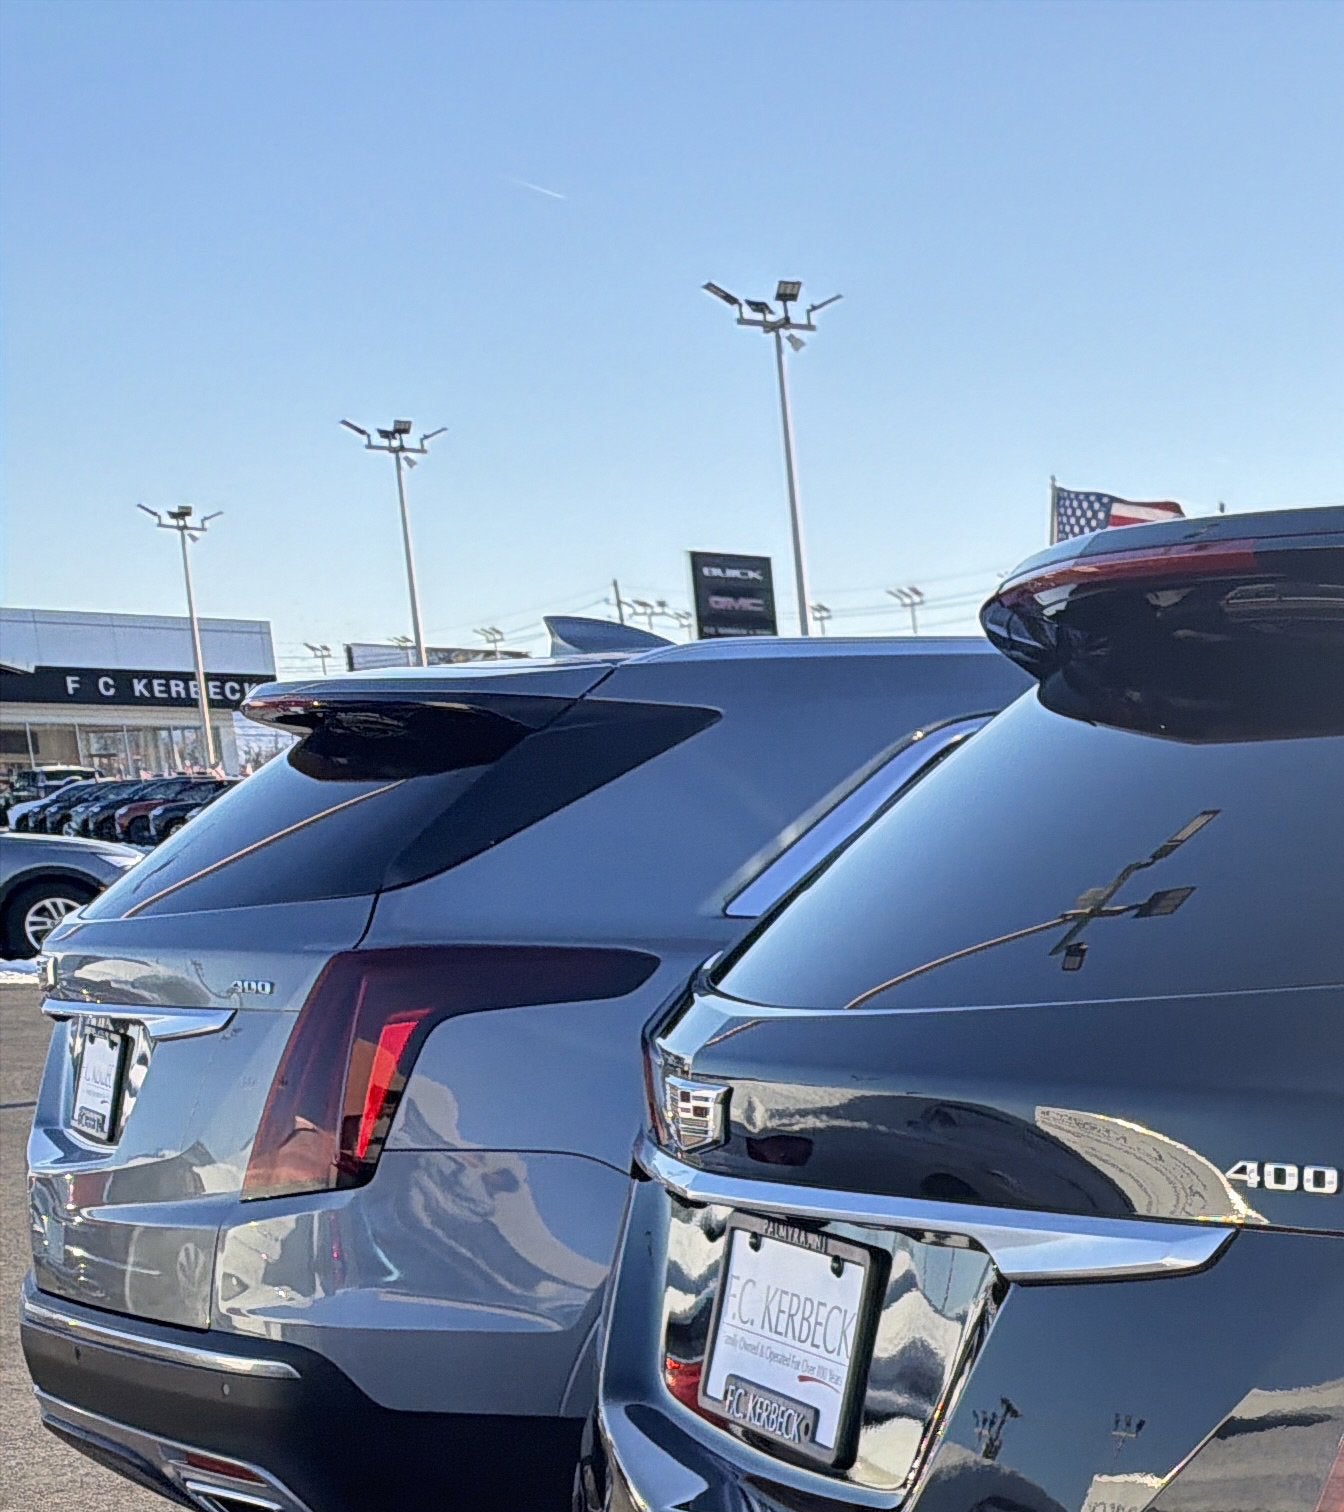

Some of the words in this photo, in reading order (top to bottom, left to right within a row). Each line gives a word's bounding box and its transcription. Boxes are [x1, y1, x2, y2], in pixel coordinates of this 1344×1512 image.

[66, 676, 80, 695] F
[98, 676, 116, 696] C
[230, 980, 271, 995] 400
[1225, 1160, 1338, 1194] 400
[761, 1285, 857, 1360] KERBECK
[745, 1392, 805, 1444] KERBECK
